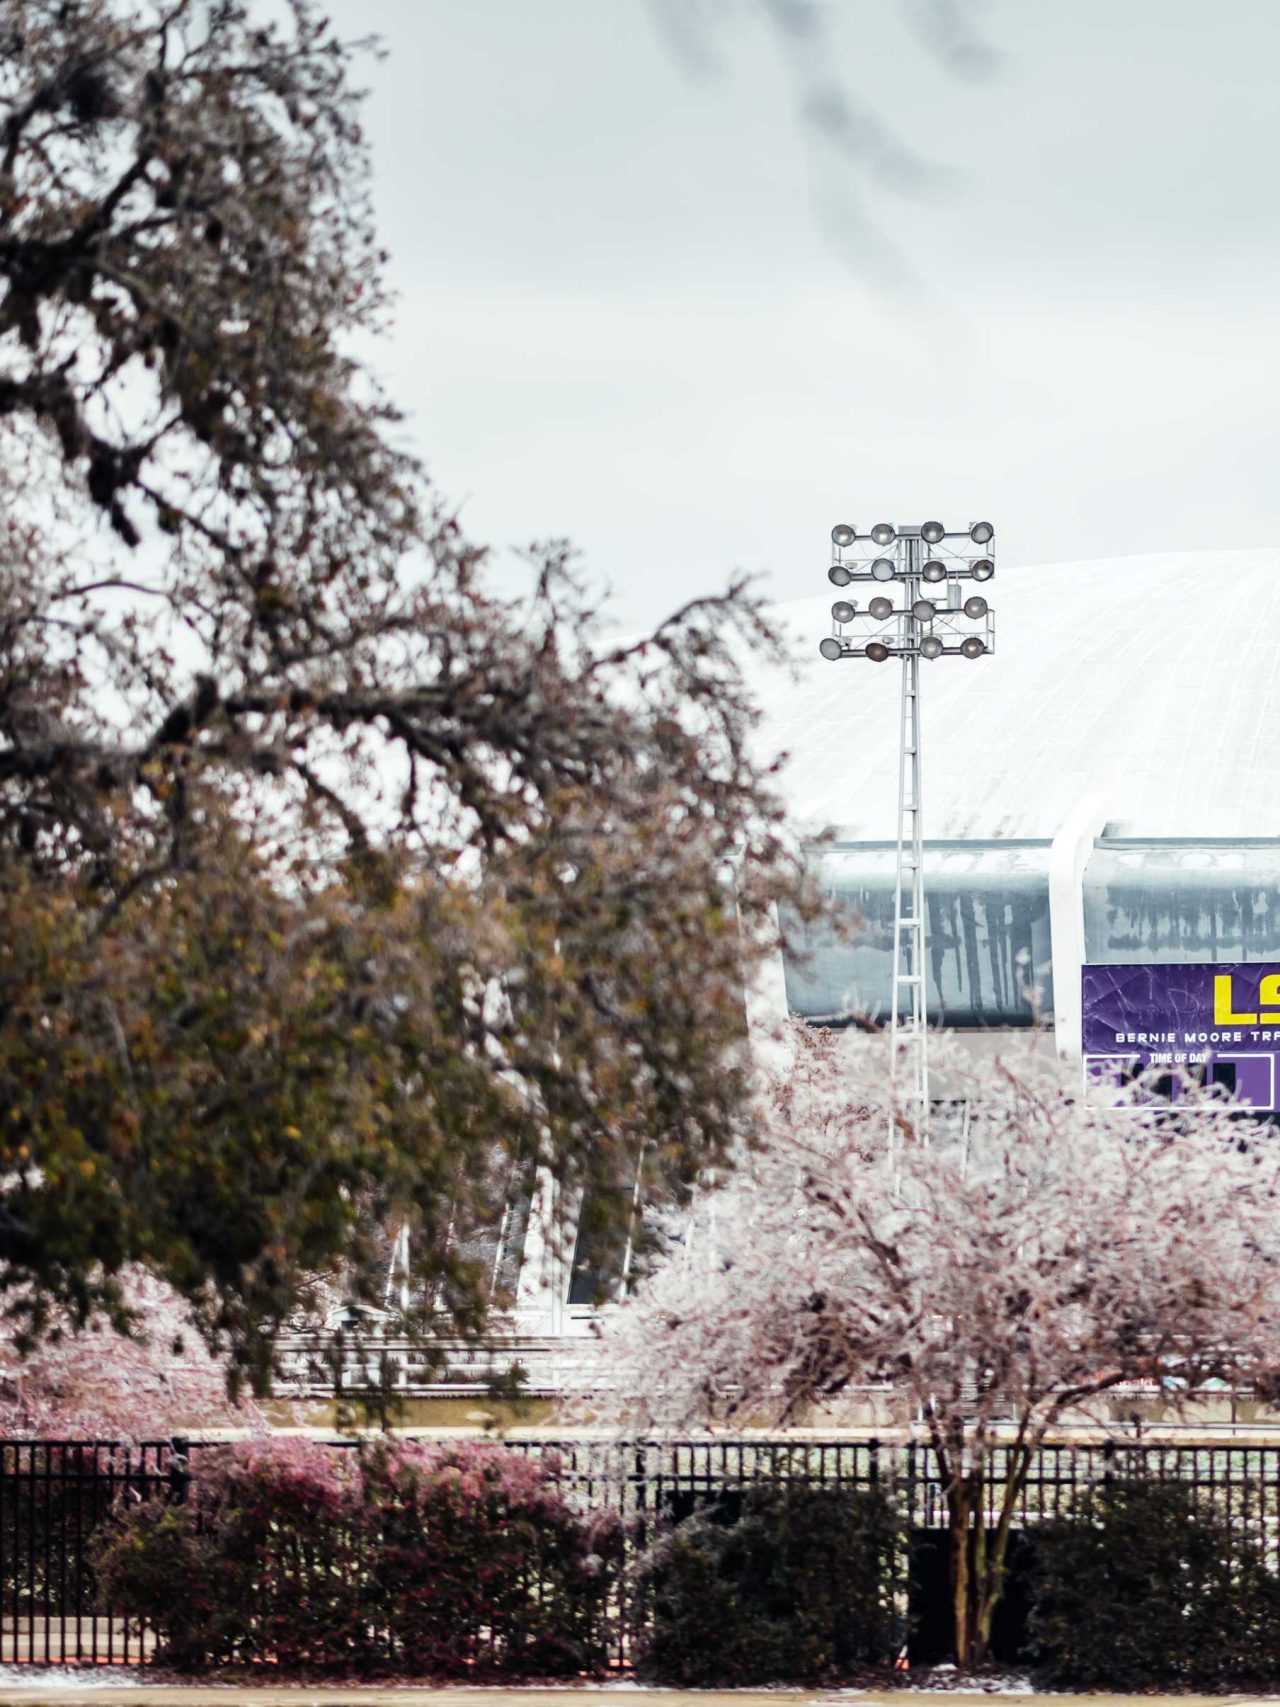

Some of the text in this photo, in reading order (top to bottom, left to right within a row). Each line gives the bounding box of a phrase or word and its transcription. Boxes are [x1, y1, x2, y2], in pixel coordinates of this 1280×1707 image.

[1115, 1032, 1177, 1043] BERNIE
[1184, 1032, 1242, 1042] MOORE
[1150, 1052, 1208, 1063] TIME OF DAY
